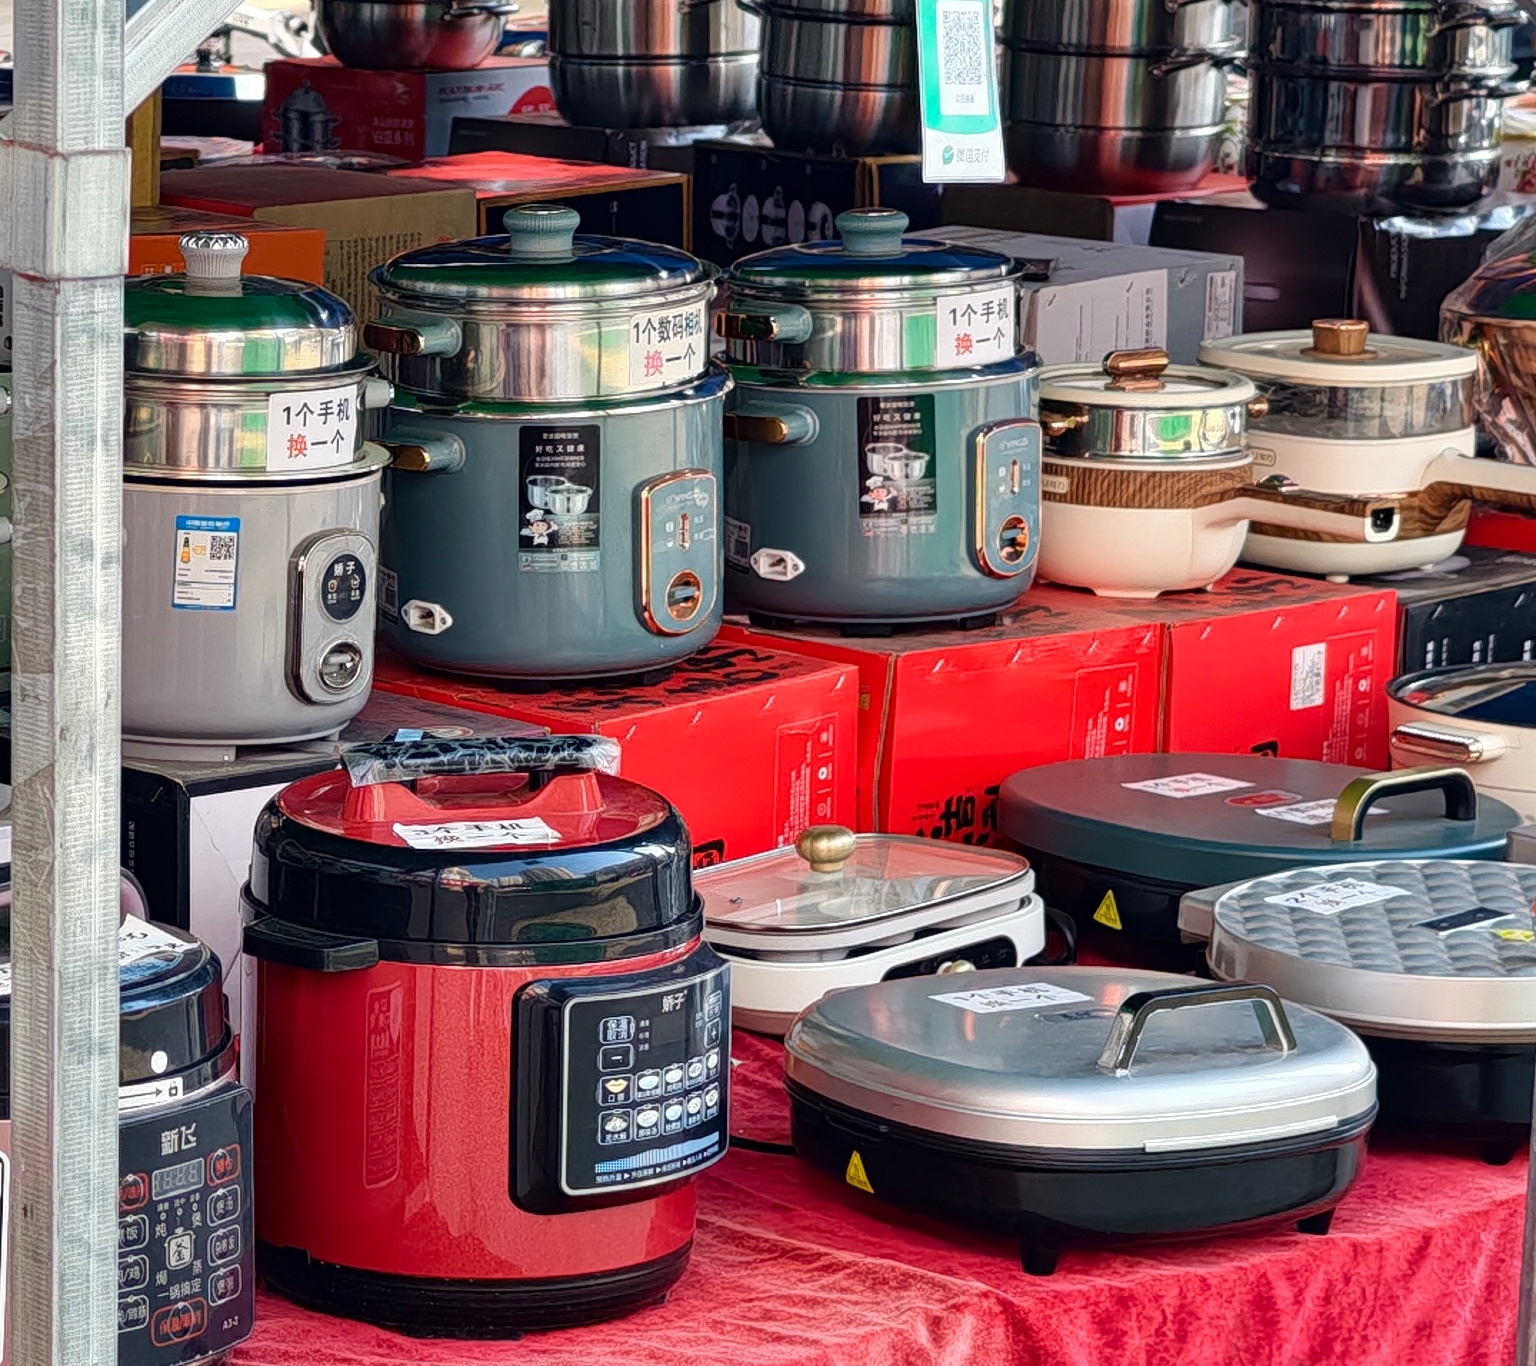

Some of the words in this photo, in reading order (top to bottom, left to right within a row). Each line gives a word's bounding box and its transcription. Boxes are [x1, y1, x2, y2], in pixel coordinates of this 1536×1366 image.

[948, 297, 1010, 327] 1个手机
[632, 310, 703, 346] 1个数码相机
[954, 326, 1006, 357] 换一个
[643, 343, 697, 378] 换一个
[282, 398, 351, 427] 1个手机
[287, 428, 345, 459] 换一个
[333, 560, 356, 577] 娇子
[160, 1122, 197, 1156] 新飞
